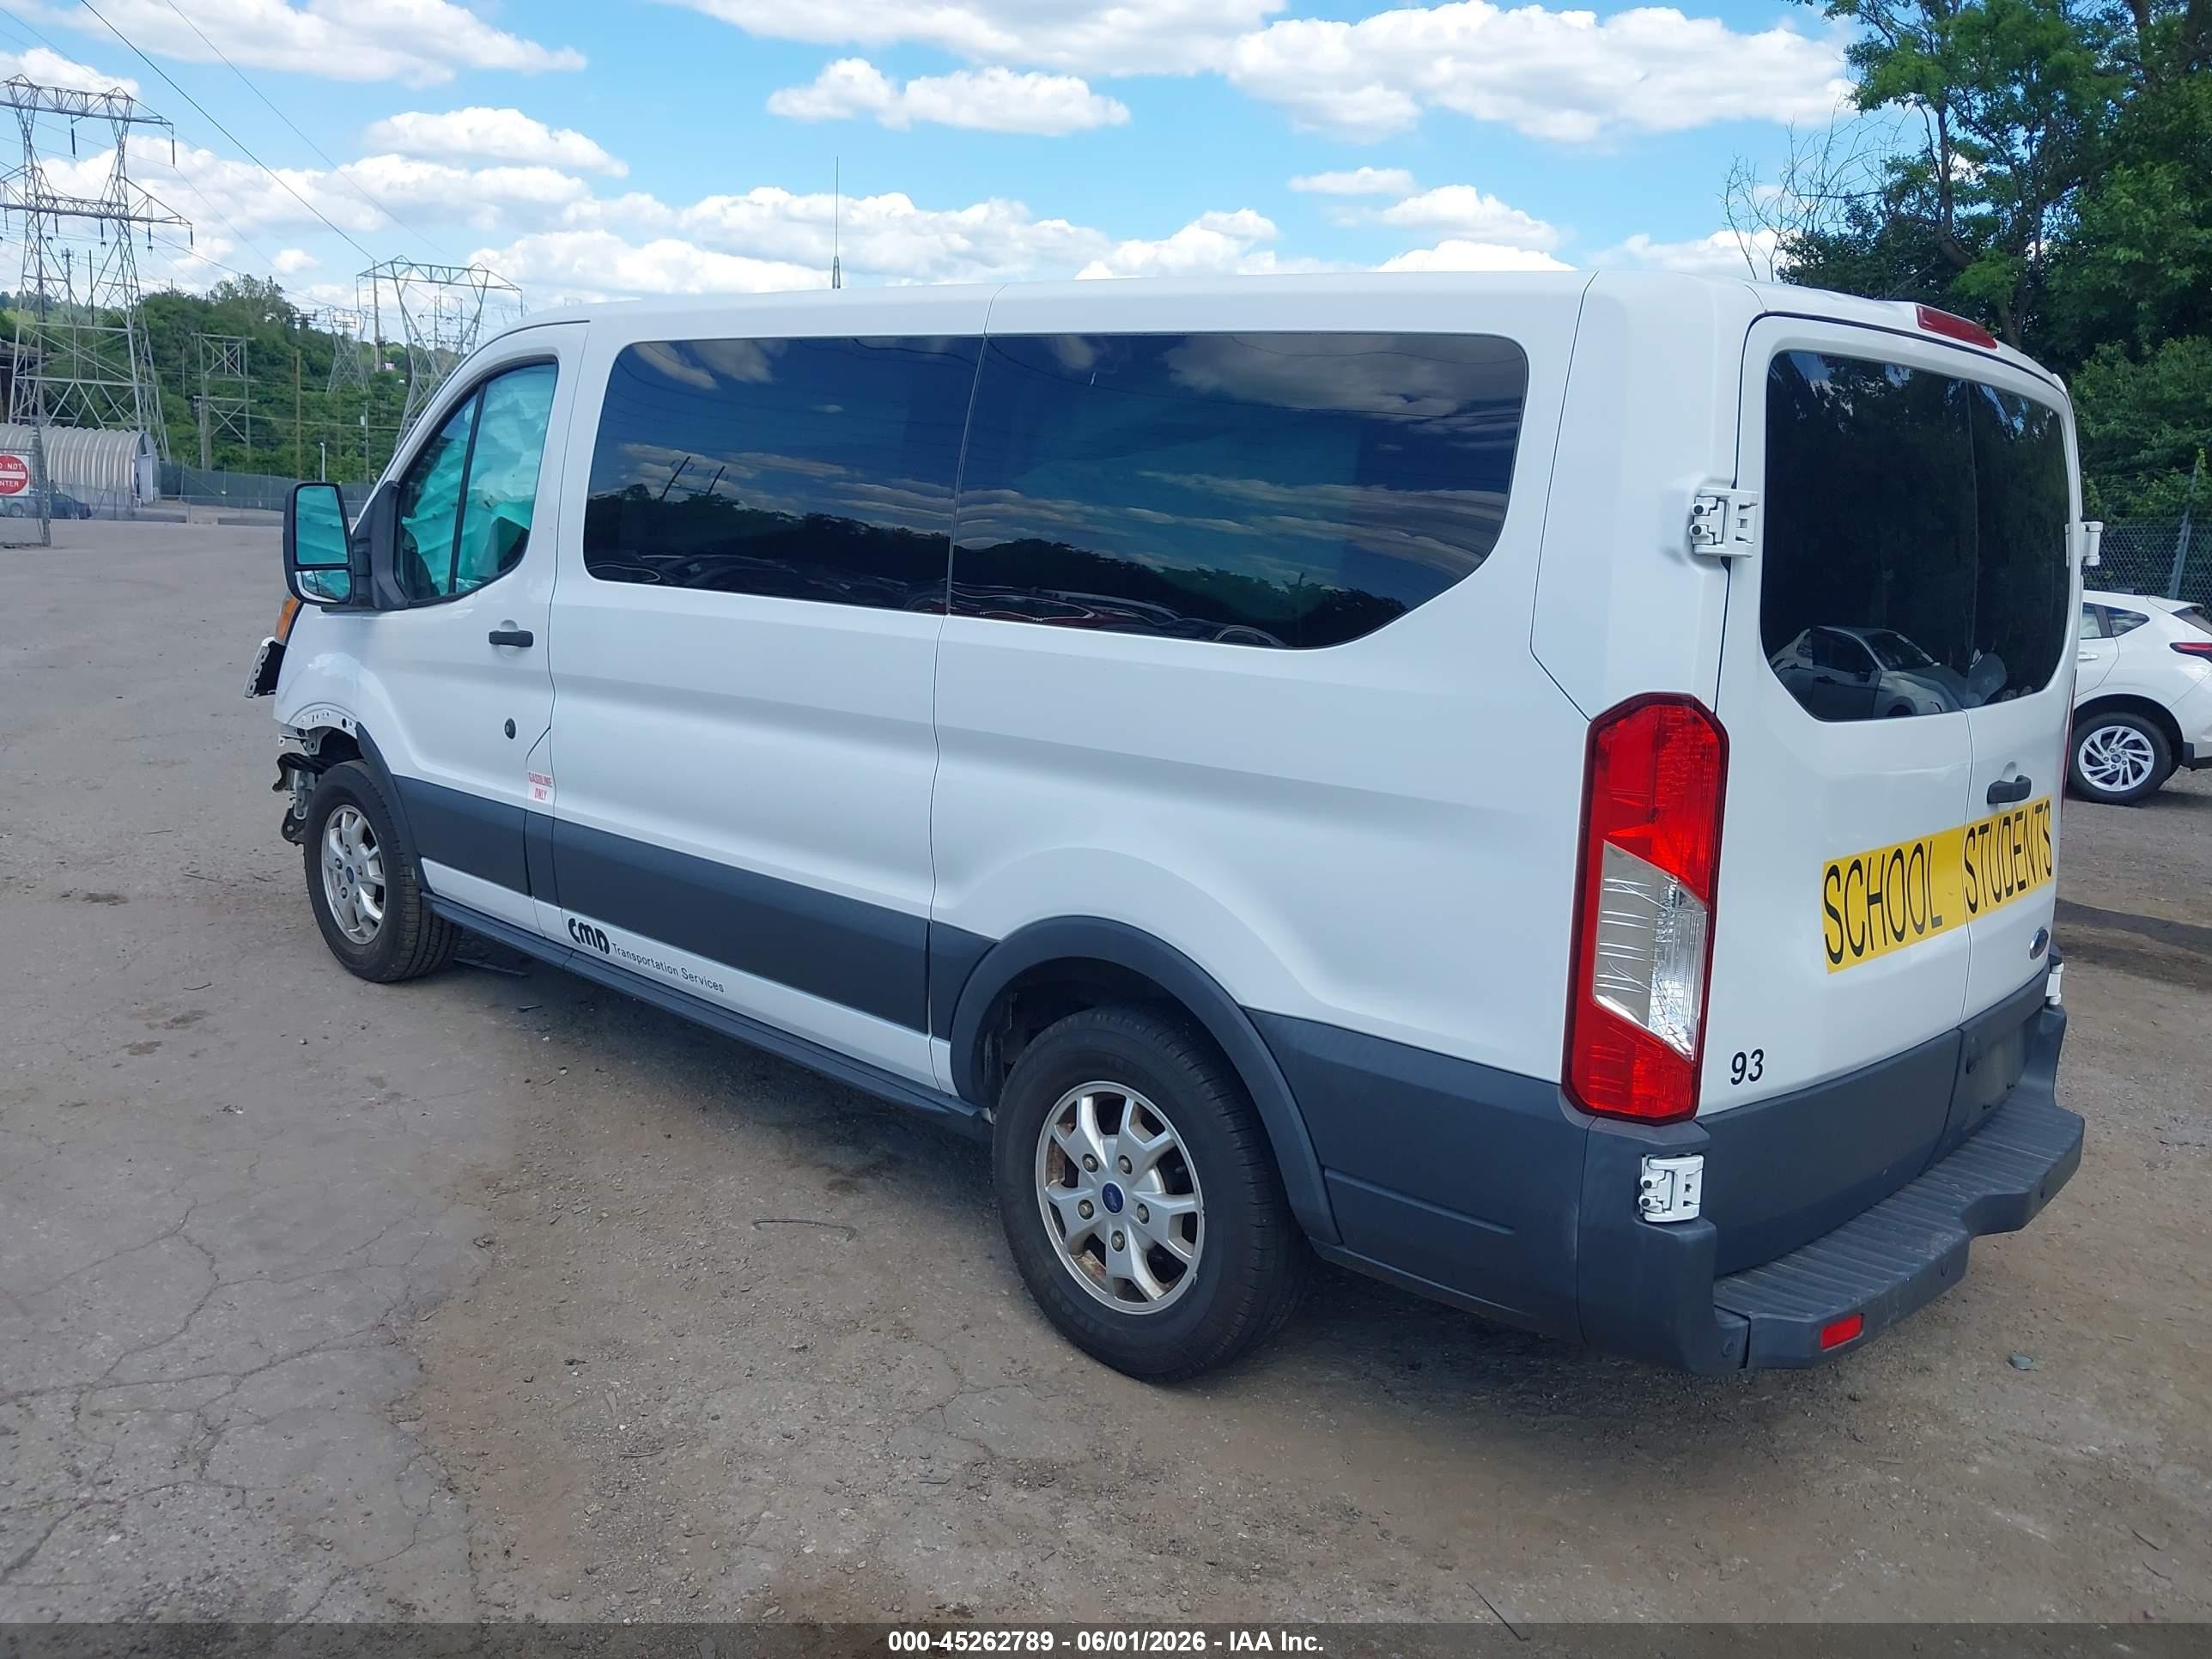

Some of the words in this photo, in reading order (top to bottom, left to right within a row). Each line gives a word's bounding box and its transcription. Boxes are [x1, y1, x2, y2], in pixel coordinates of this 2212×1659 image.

[528, 772, 552, 788] GASOLINE
[535, 787, 547, 800] ONLY
[1824, 841, 1942, 964] SCHOOL
[1965, 799, 2052, 915] STUDENTS
[611, 942, 678, 976] Transportation
[681, 967, 724, 993] Services
[1730, 1048, 1765, 1085] 93
